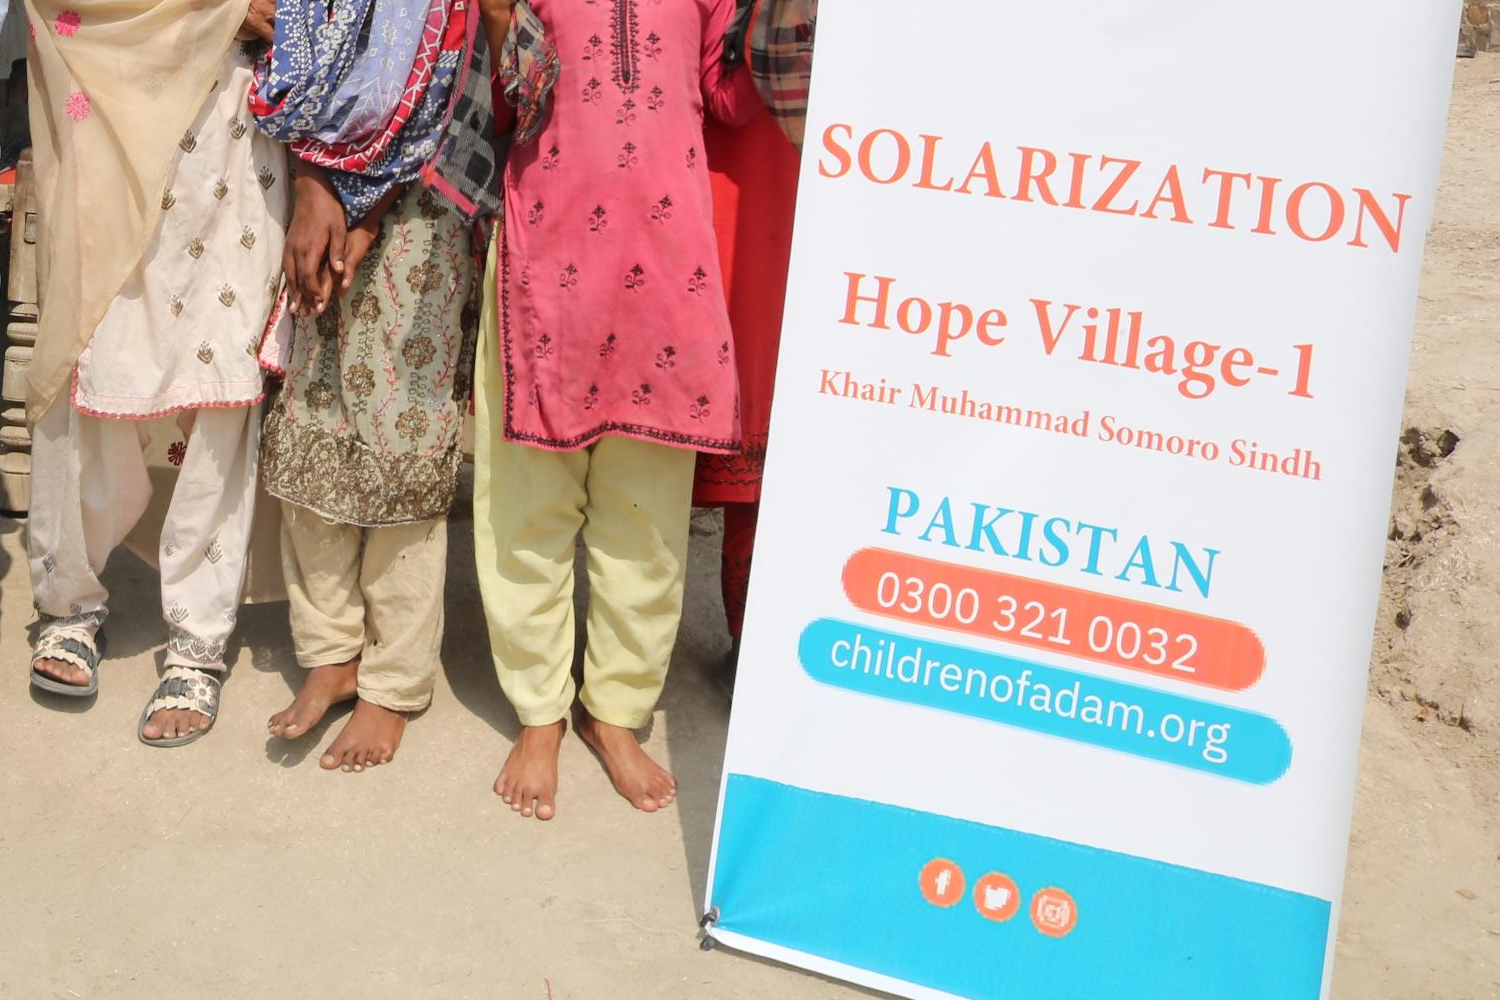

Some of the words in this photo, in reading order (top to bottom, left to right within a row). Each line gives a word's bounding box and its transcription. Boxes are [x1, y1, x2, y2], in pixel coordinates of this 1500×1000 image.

[818, 123, 1412, 254] SOLARIZATION
[838, 272, 1008, 358] Hope
[1030, 299, 1315, 400] Village-1
[818, 369, 902, 406] Khair
[908, 383, 1090, 438] Muhammad
[1099, 415, 1220, 462] Somoro
[1229, 439, 1323, 481] Sindh
[881, 486, 1221, 599] PAKISTAN
[877, 572, 980, 625] 0300
[993, 595, 1071, 646] 321
[1087, 615, 1199, 674] 0032
[830, 634, 1232, 764] childrenofadam.org
